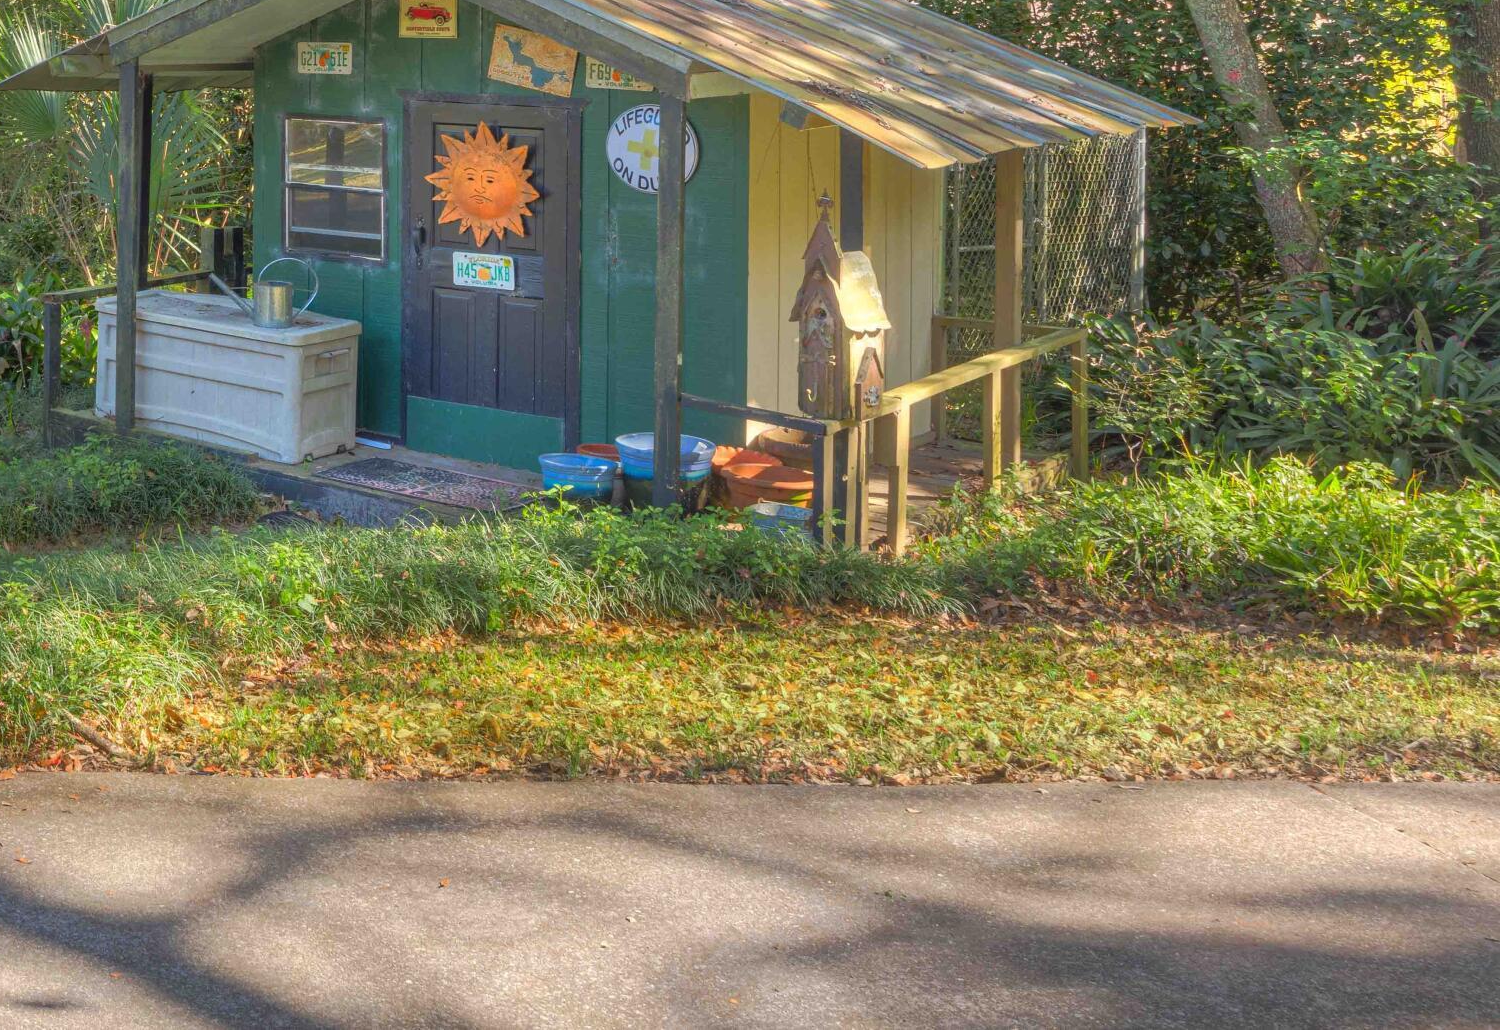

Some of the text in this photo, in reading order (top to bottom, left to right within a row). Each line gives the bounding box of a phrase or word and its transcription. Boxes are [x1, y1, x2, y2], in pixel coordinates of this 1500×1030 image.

[613, 157, 660, 192] ON DU
[457, 262, 510, 282] H45 JKB
